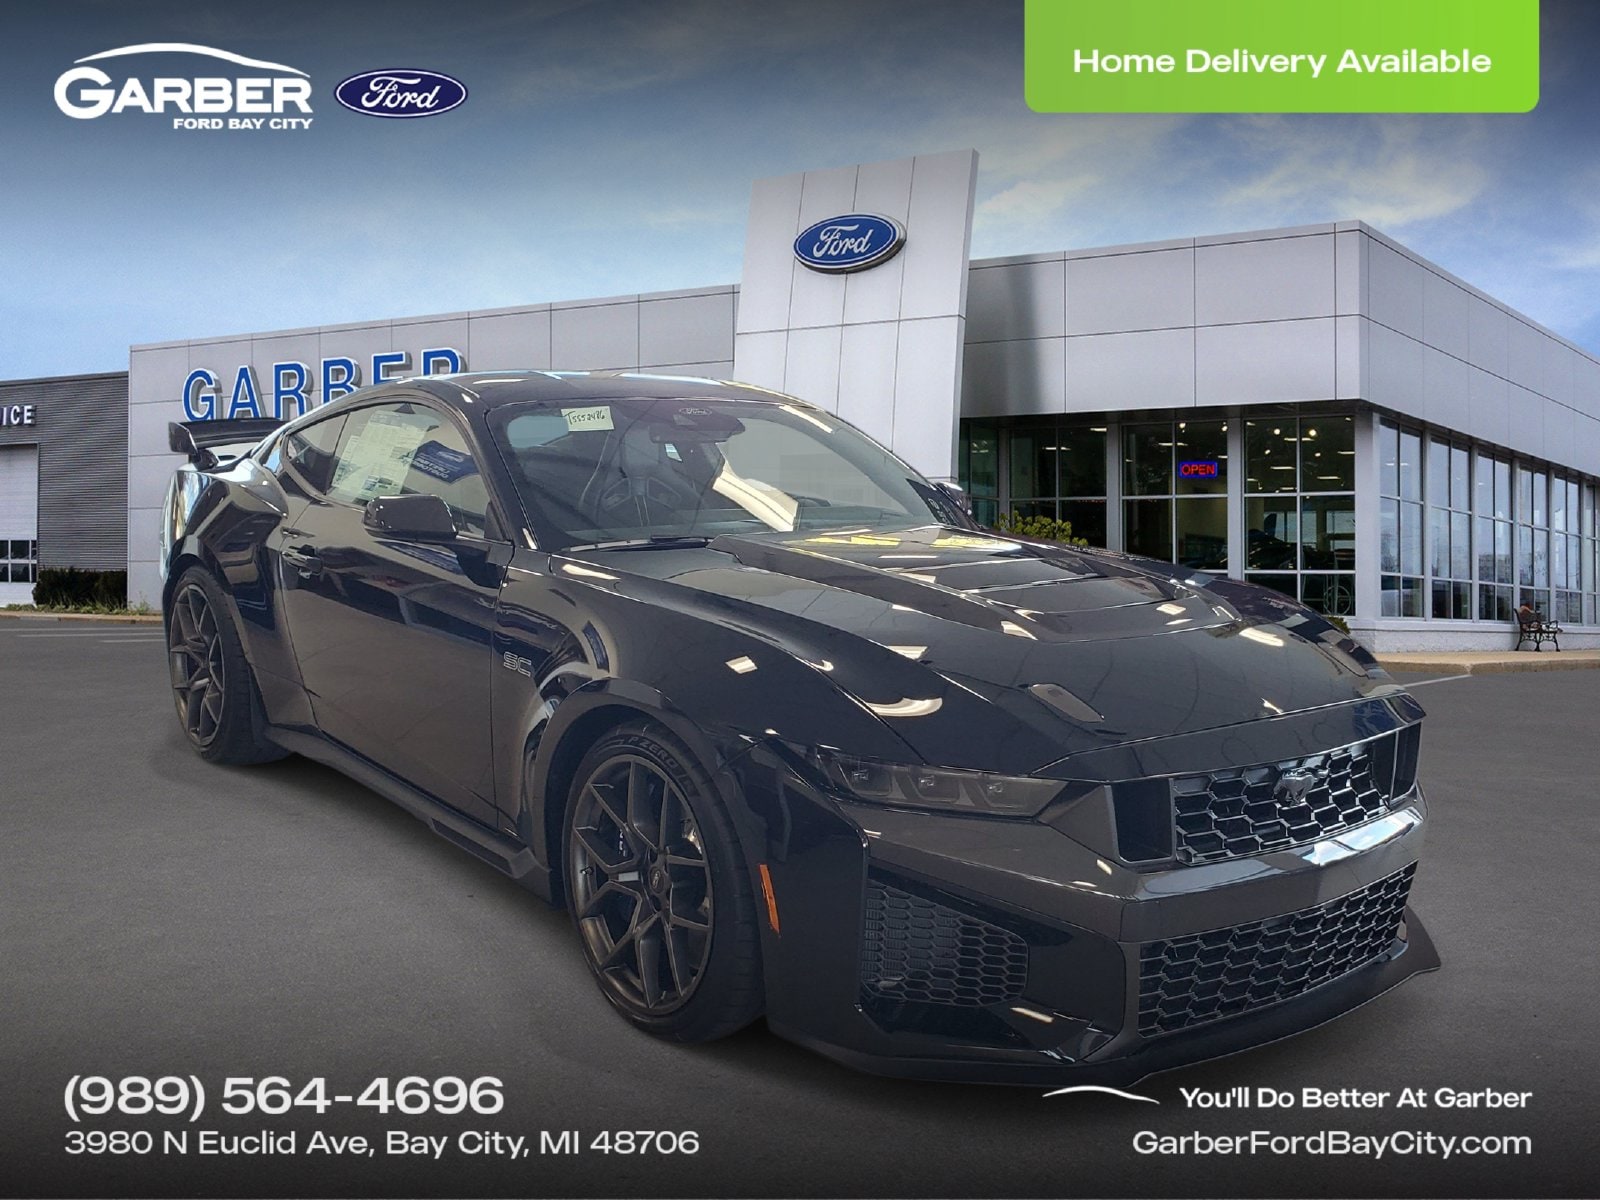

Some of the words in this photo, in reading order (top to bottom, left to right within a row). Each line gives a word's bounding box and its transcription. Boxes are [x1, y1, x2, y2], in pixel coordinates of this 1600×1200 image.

[812, 224, 874, 258] Ford
[1181, 463, 1215, 476] OPEN
[639, 739, 680, 769] ZERO
